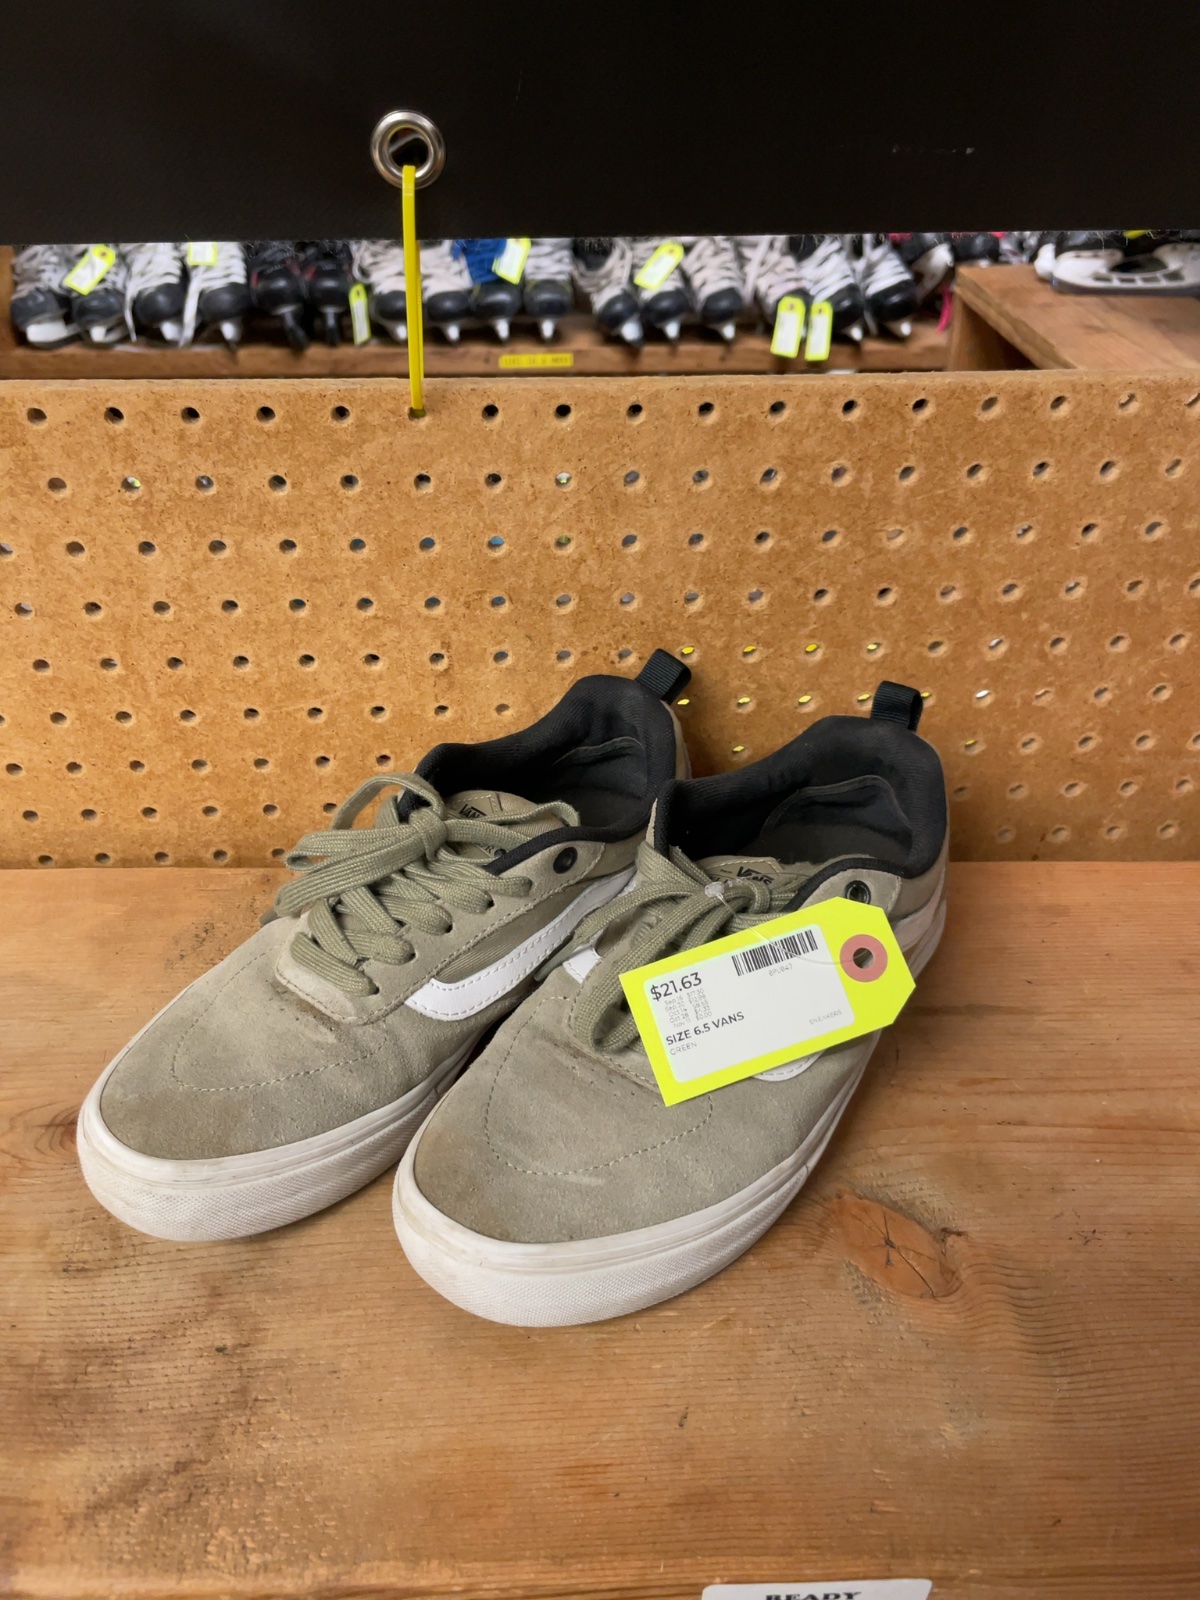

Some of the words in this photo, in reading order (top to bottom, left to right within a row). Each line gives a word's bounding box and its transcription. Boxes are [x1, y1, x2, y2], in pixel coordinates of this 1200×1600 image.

[650, 972, 702, 1002] $21.63
[665, 1029, 692, 1046] SIZE
[693, 1022, 711, 1036] 6.5
[711, 1011, 745, 1030] VANS
[808, 1009, 843, 1025] SNEAKERS
[669, 1042, 698, 1056] GREEN
